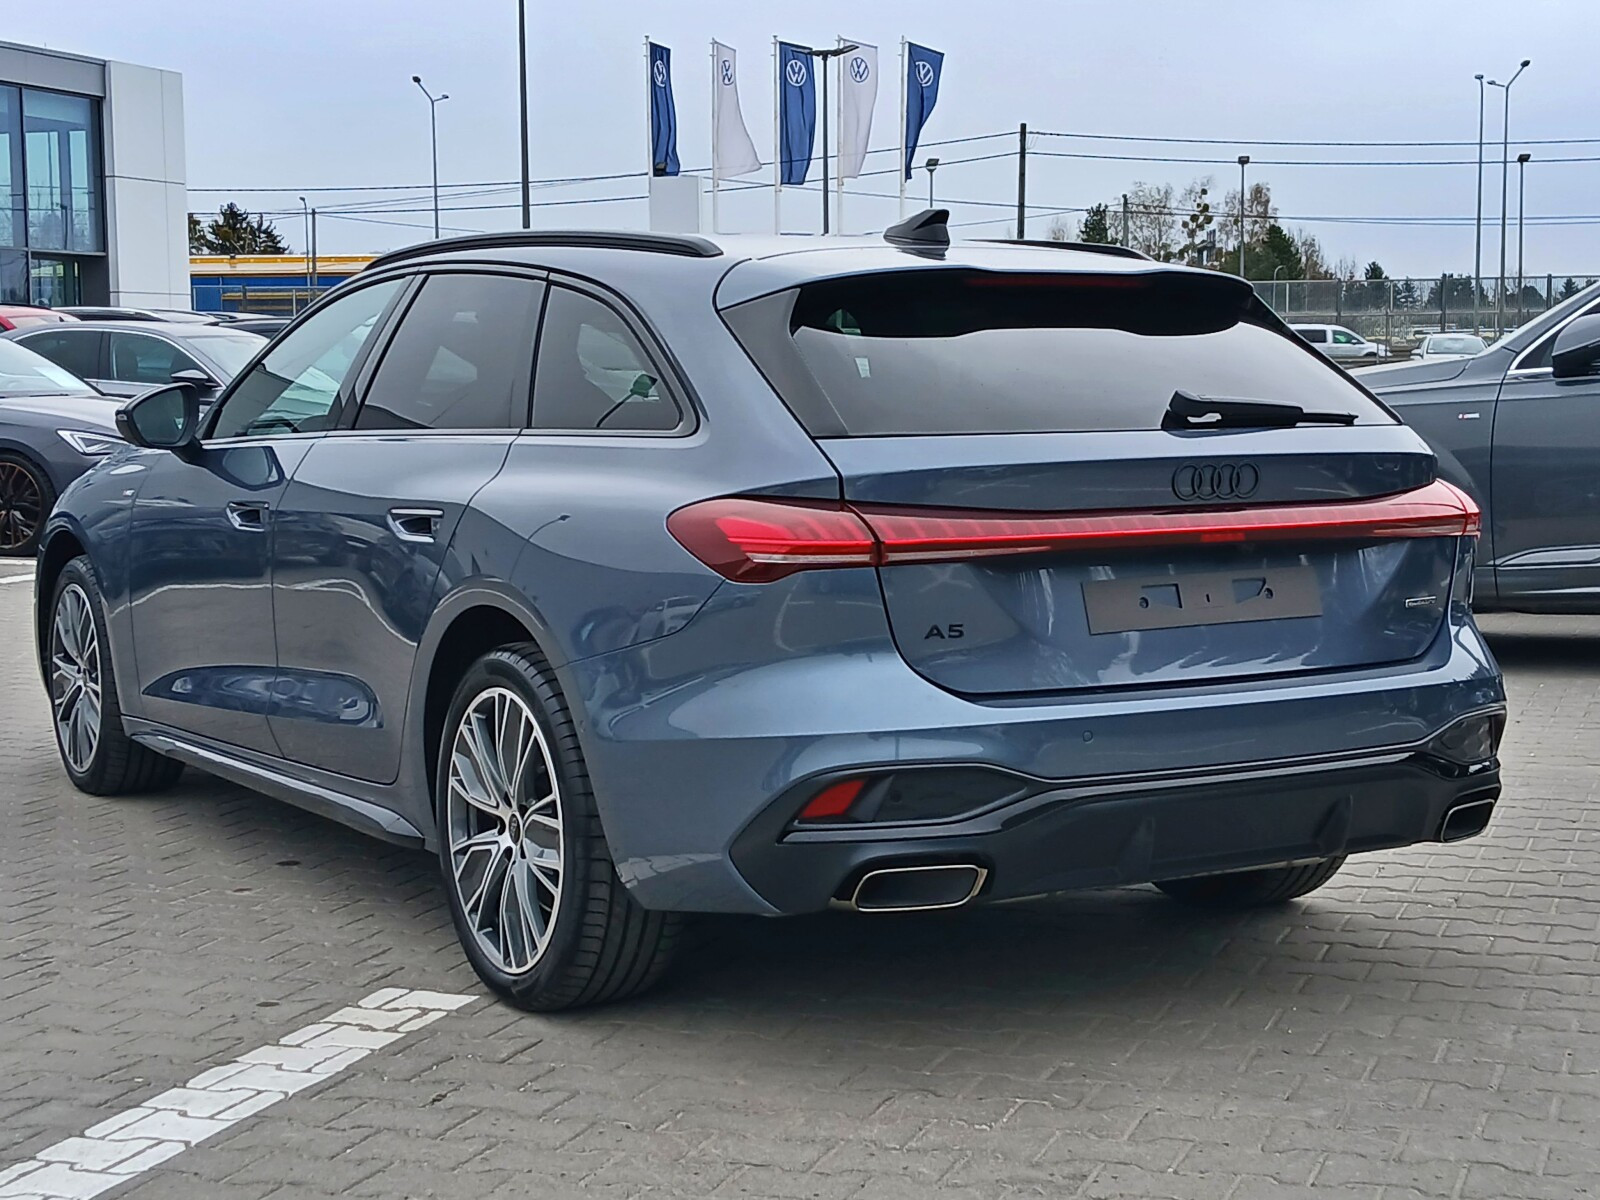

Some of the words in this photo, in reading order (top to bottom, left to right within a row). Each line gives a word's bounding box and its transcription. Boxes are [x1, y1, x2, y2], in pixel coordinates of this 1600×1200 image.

[786, 59, 807, 87] VW
[850, 56, 870, 83] VW
[924, 624, 964, 639] A5
